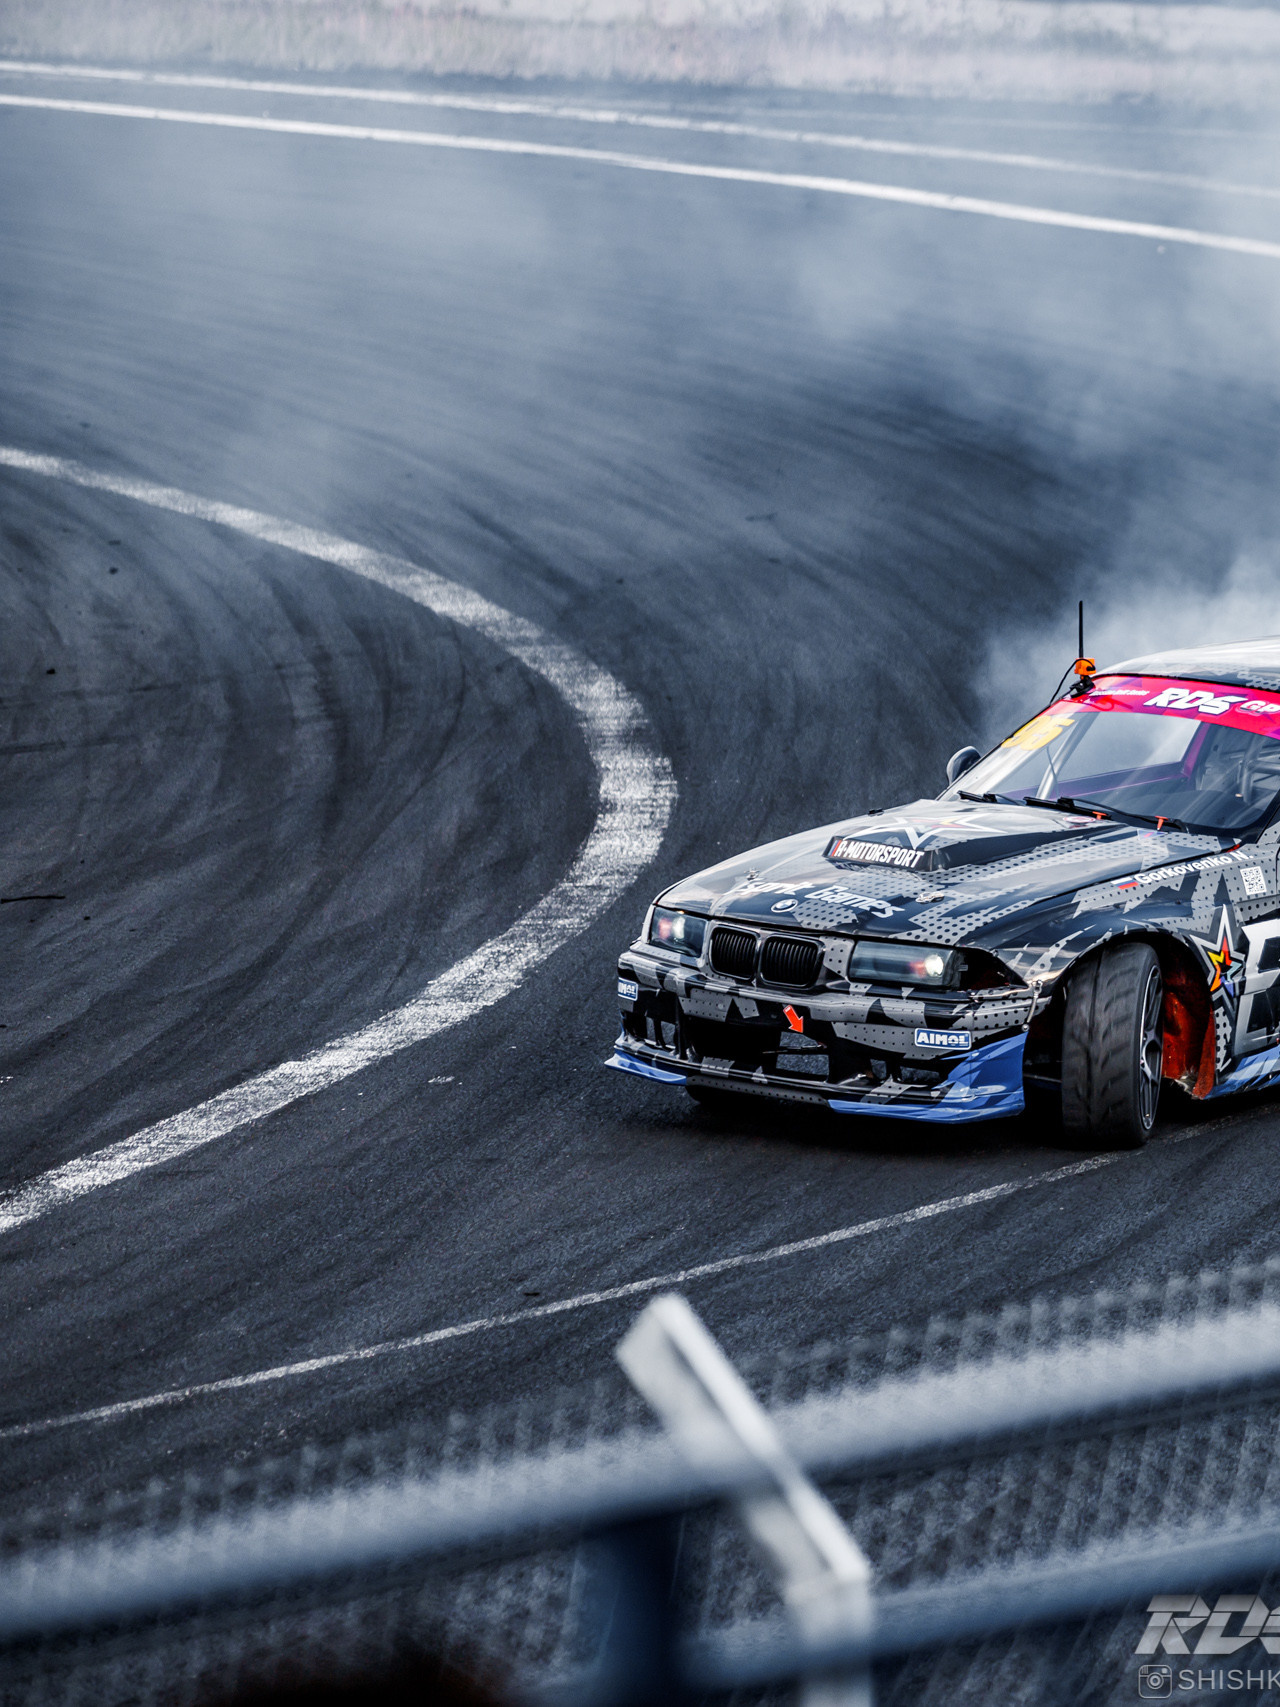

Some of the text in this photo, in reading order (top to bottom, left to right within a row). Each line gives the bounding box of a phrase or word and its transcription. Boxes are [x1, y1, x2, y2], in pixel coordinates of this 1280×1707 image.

[1143, 687, 1248, 715] RDS
[1001, 714, 1075, 751] 95
[1134, 850, 1254, 884] Gorkovenko N.
[917, 1032, 969, 1046] AIMOL
